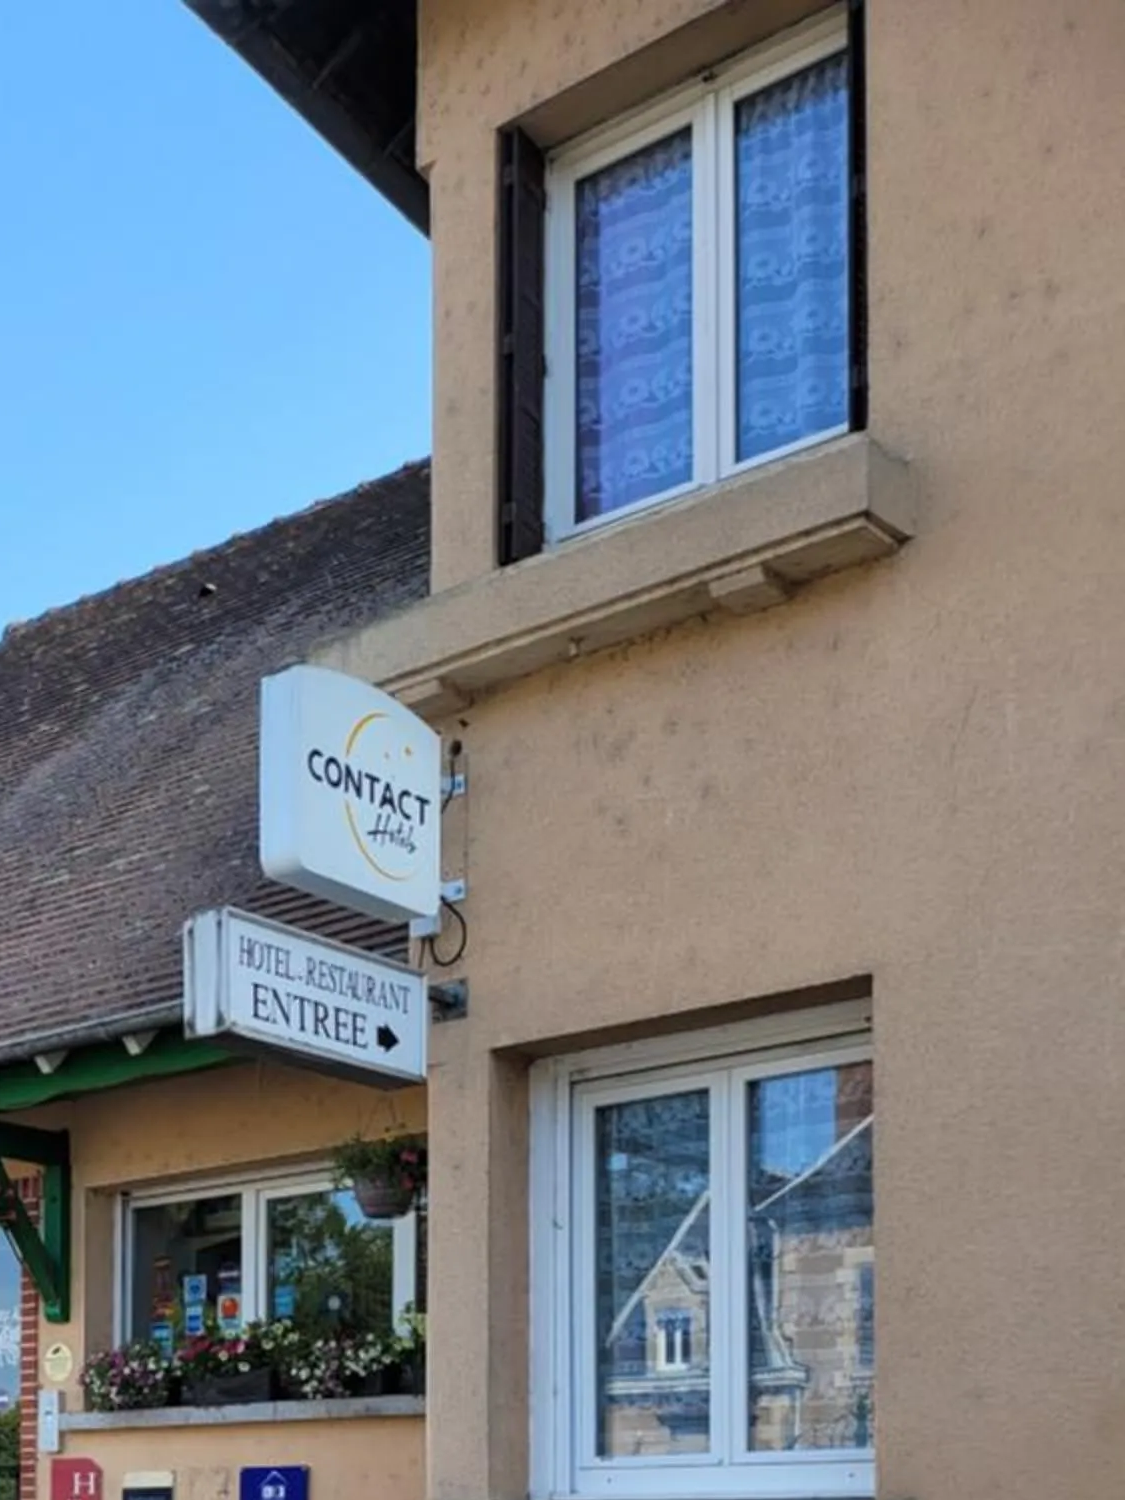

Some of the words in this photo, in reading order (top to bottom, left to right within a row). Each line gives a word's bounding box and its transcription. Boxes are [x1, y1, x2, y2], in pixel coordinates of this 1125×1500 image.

[307, 748, 431, 826] CONTACT
[251, 982, 369, 1049] ENTREE
[73, 1471, 95, 1496] H
